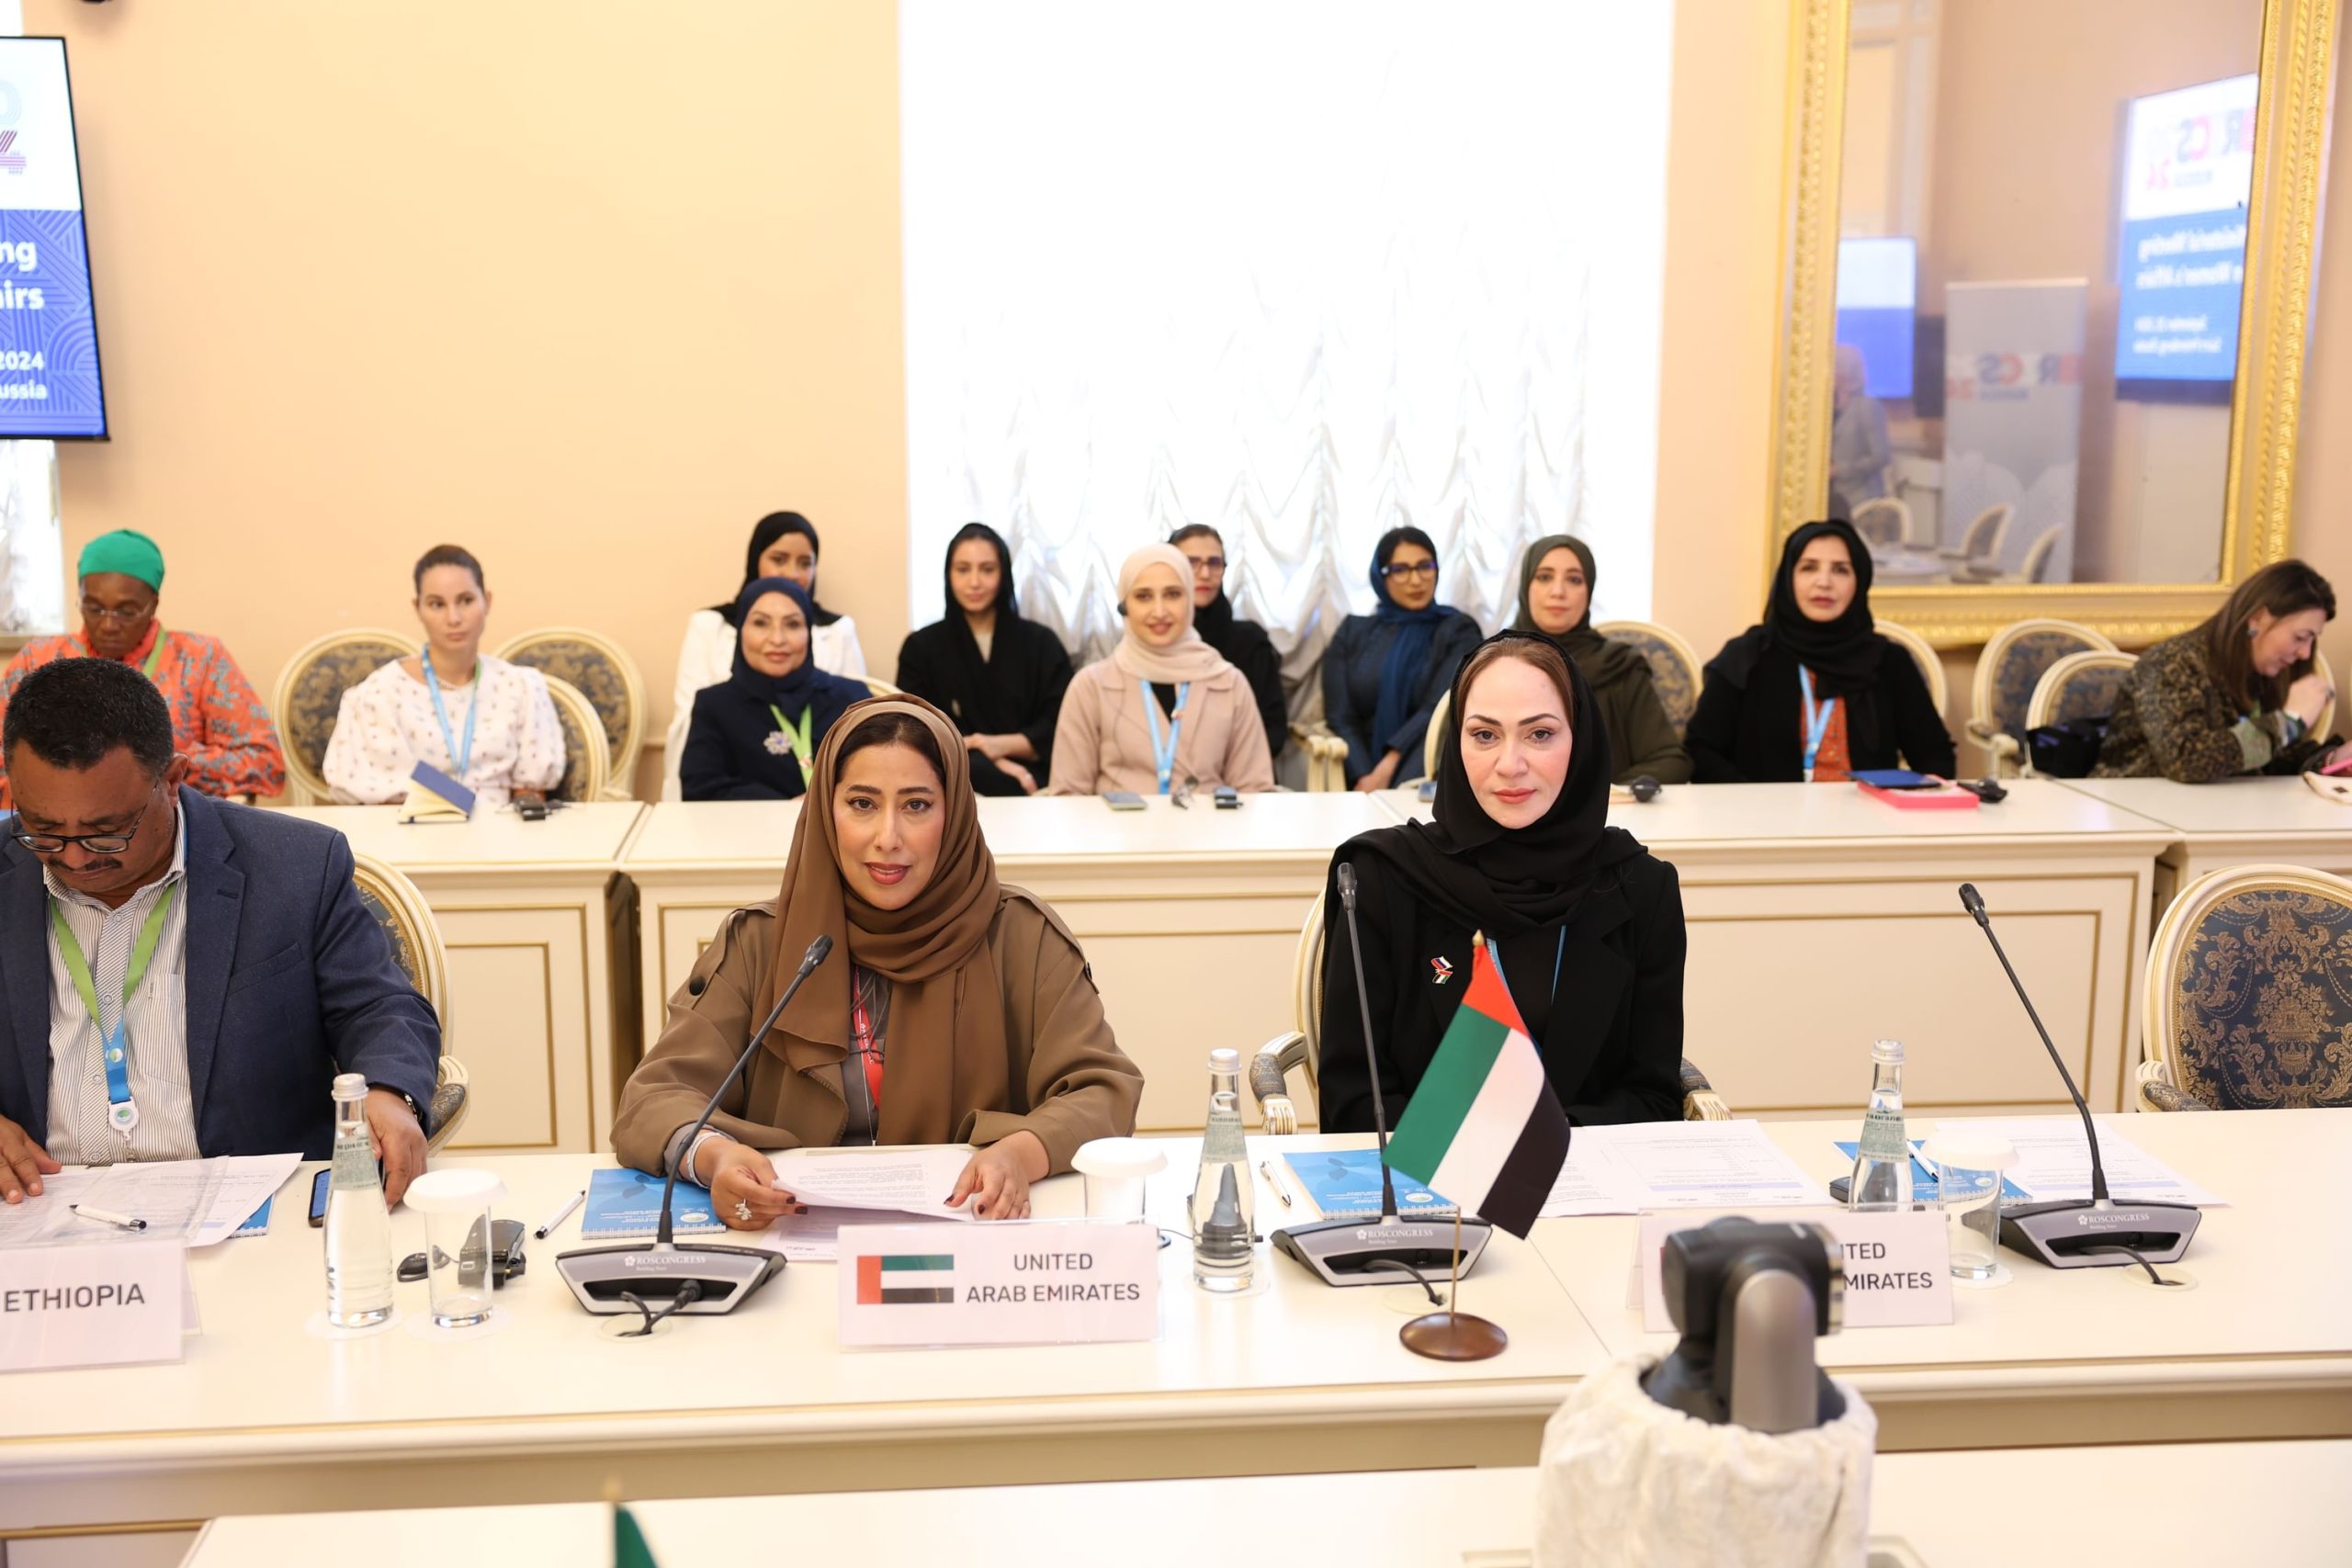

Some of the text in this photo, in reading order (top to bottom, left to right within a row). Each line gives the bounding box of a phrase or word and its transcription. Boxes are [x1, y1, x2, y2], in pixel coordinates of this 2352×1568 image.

[0, 279, 45, 310] irs
[2088, 1213, 2150, 1223] ROSCONGRESS
[1368, 1229, 1433, 1239] ROSCONGRESS
[636, 1256, 707, 1266] ROSCONGRESS
[1013, 1253, 1092, 1270] UNITED
[1843, 1271, 1933, 1291] MIRATES
[5, 1283, 145, 1312] ETHIOPIA
[967, 1283, 1140, 1303] ARAB EMIRATES
